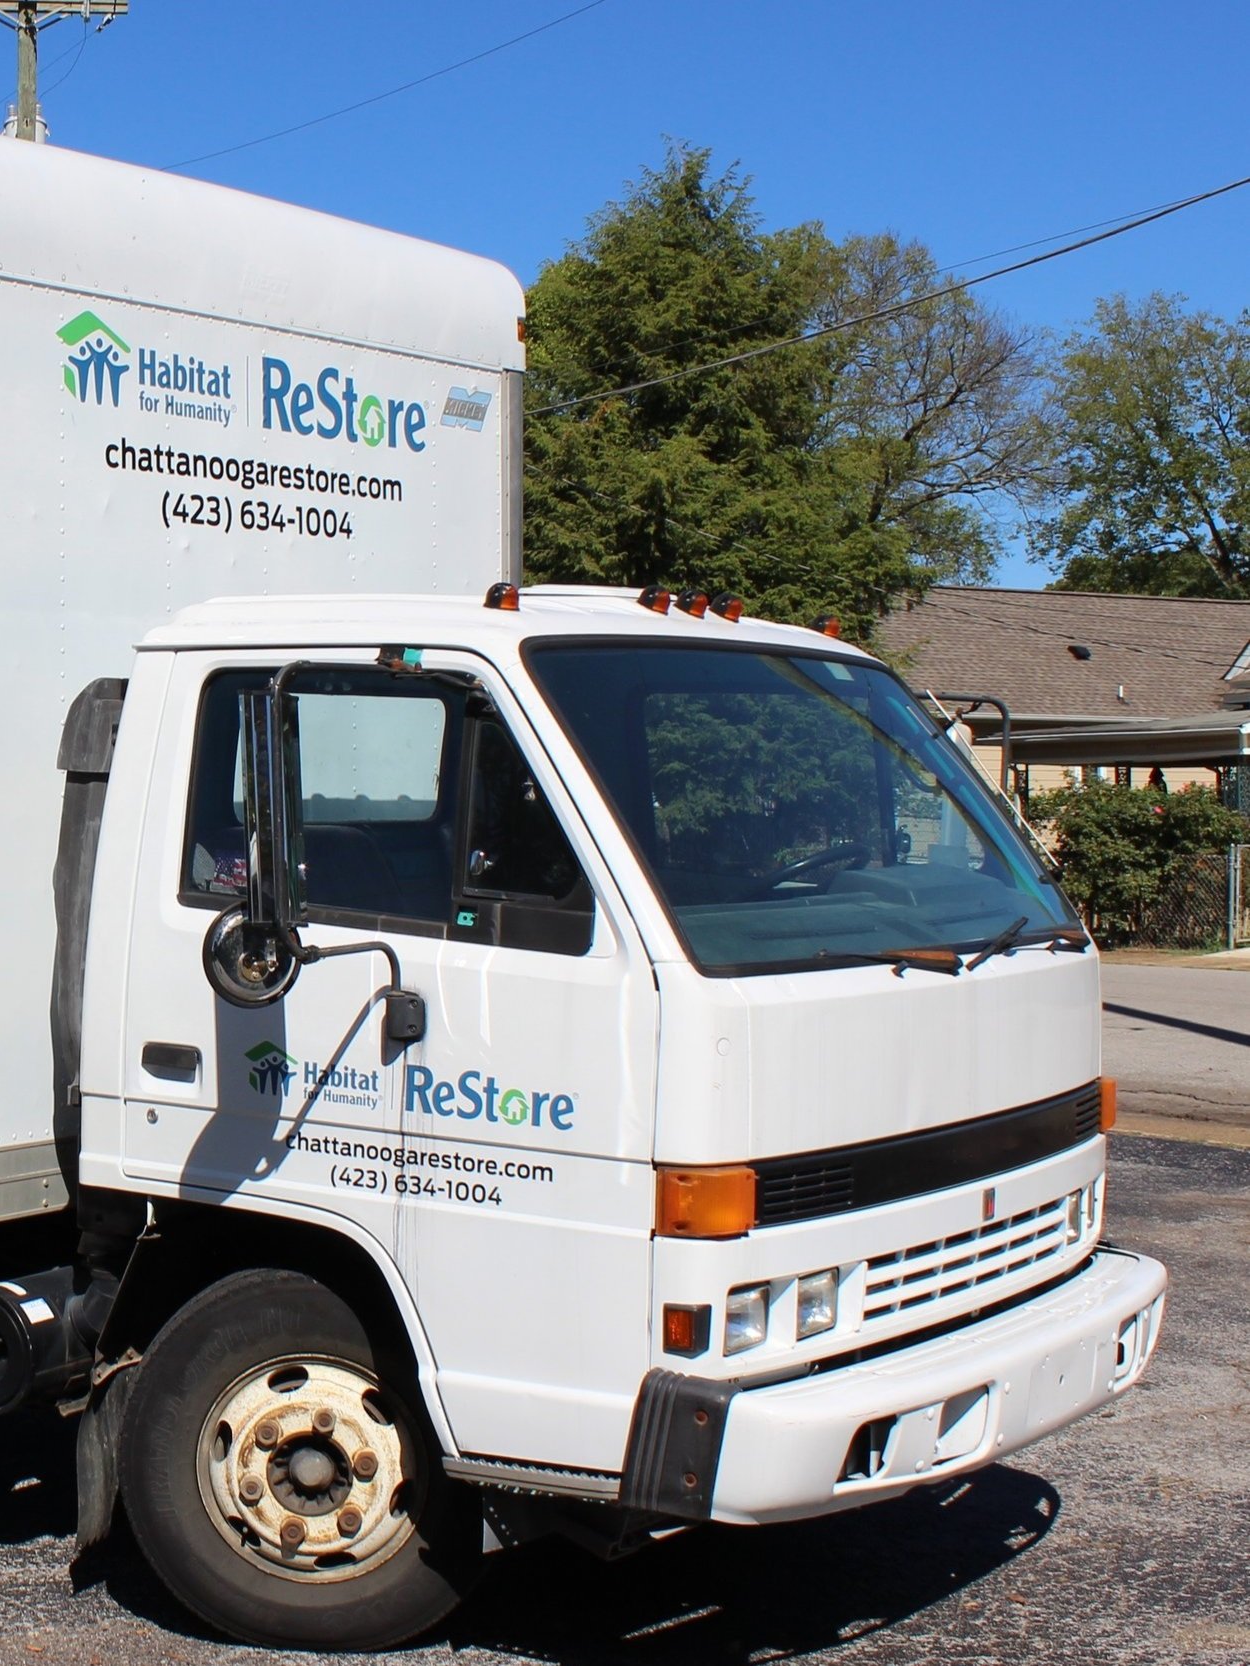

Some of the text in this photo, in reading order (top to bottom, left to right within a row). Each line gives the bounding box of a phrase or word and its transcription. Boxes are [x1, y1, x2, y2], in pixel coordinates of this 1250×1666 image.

[138, 348, 231, 400] Habitat
[139, 390, 231, 428] for Humanity
[261, 356, 427, 453] ReStore
[105, 438, 403, 502] chattanoogarestore.com
[161, 490, 353, 540] (423) 634-1004
[303, 1088, 378, 1110] for Humanity
[304, 1061, 378, 1092] Habitat
[405, 1065, 575, 1131] ReStore
[286, 1133, 554, 1182] chattanoogarestore.com
[330, 1165, 502, 1206] (423) 634-1004
